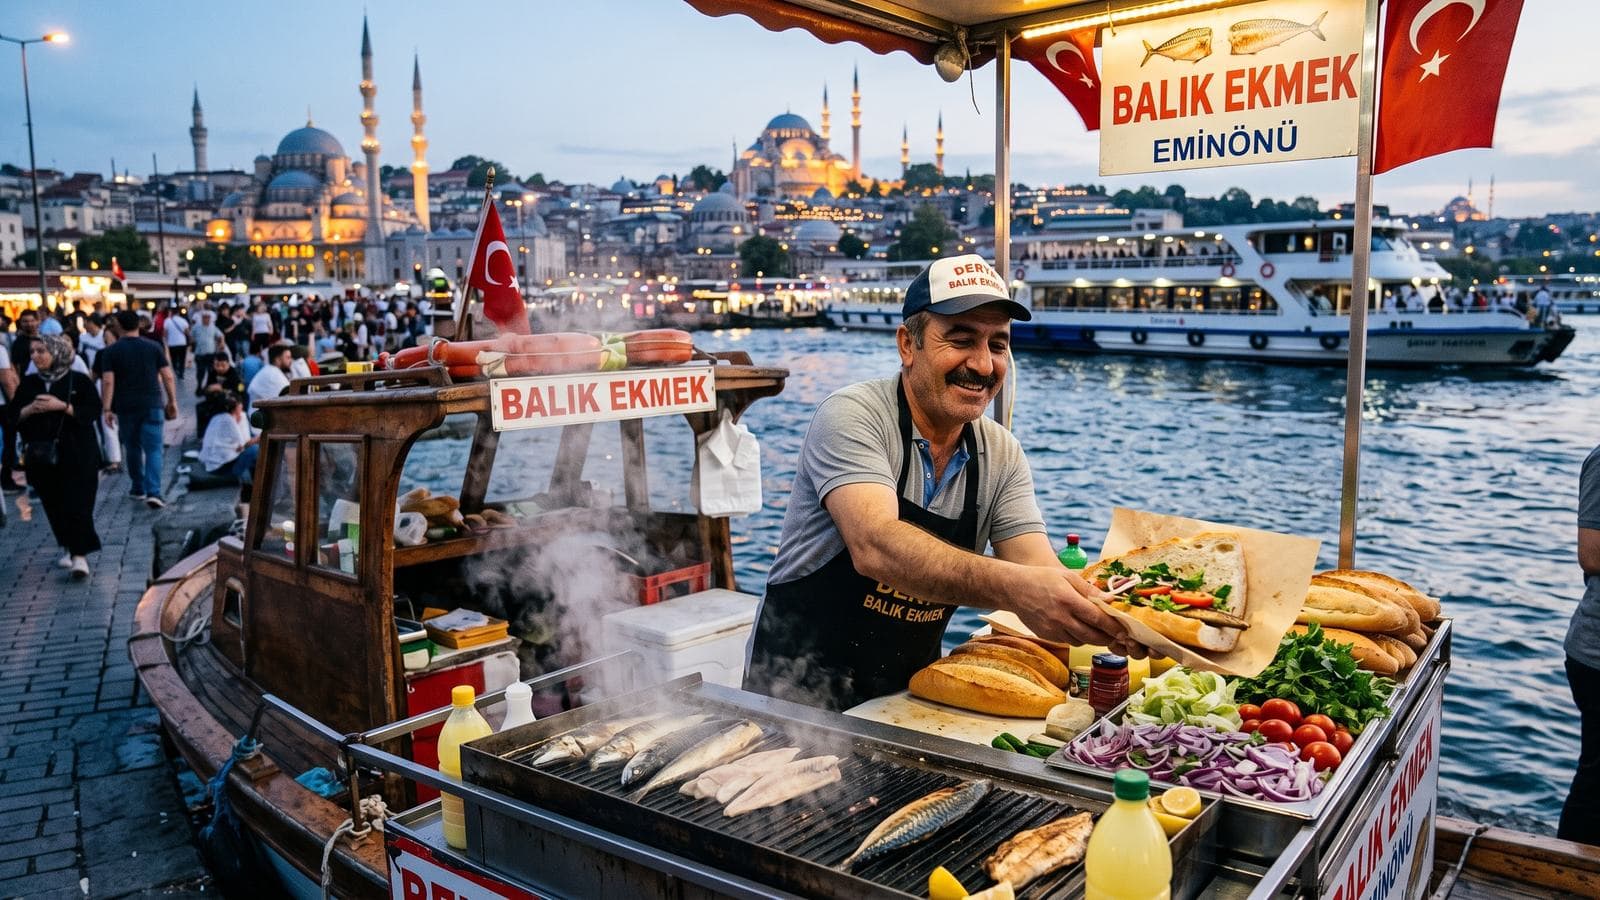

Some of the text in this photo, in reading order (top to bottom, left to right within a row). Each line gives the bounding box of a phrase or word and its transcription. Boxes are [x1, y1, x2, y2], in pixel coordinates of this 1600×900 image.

[1112, 53, 1360, 125] BALIK EKMEK
[1153, 120, 1298, 163] EMİNÖNÜ
[948, 278, 978, 289] BALIK
[501, 375, 709, 420] BALIK EKMEK
[863, 594, 945, 622] BALIK EKMEK
[1388, 717, 1435, 844] EKMEK
